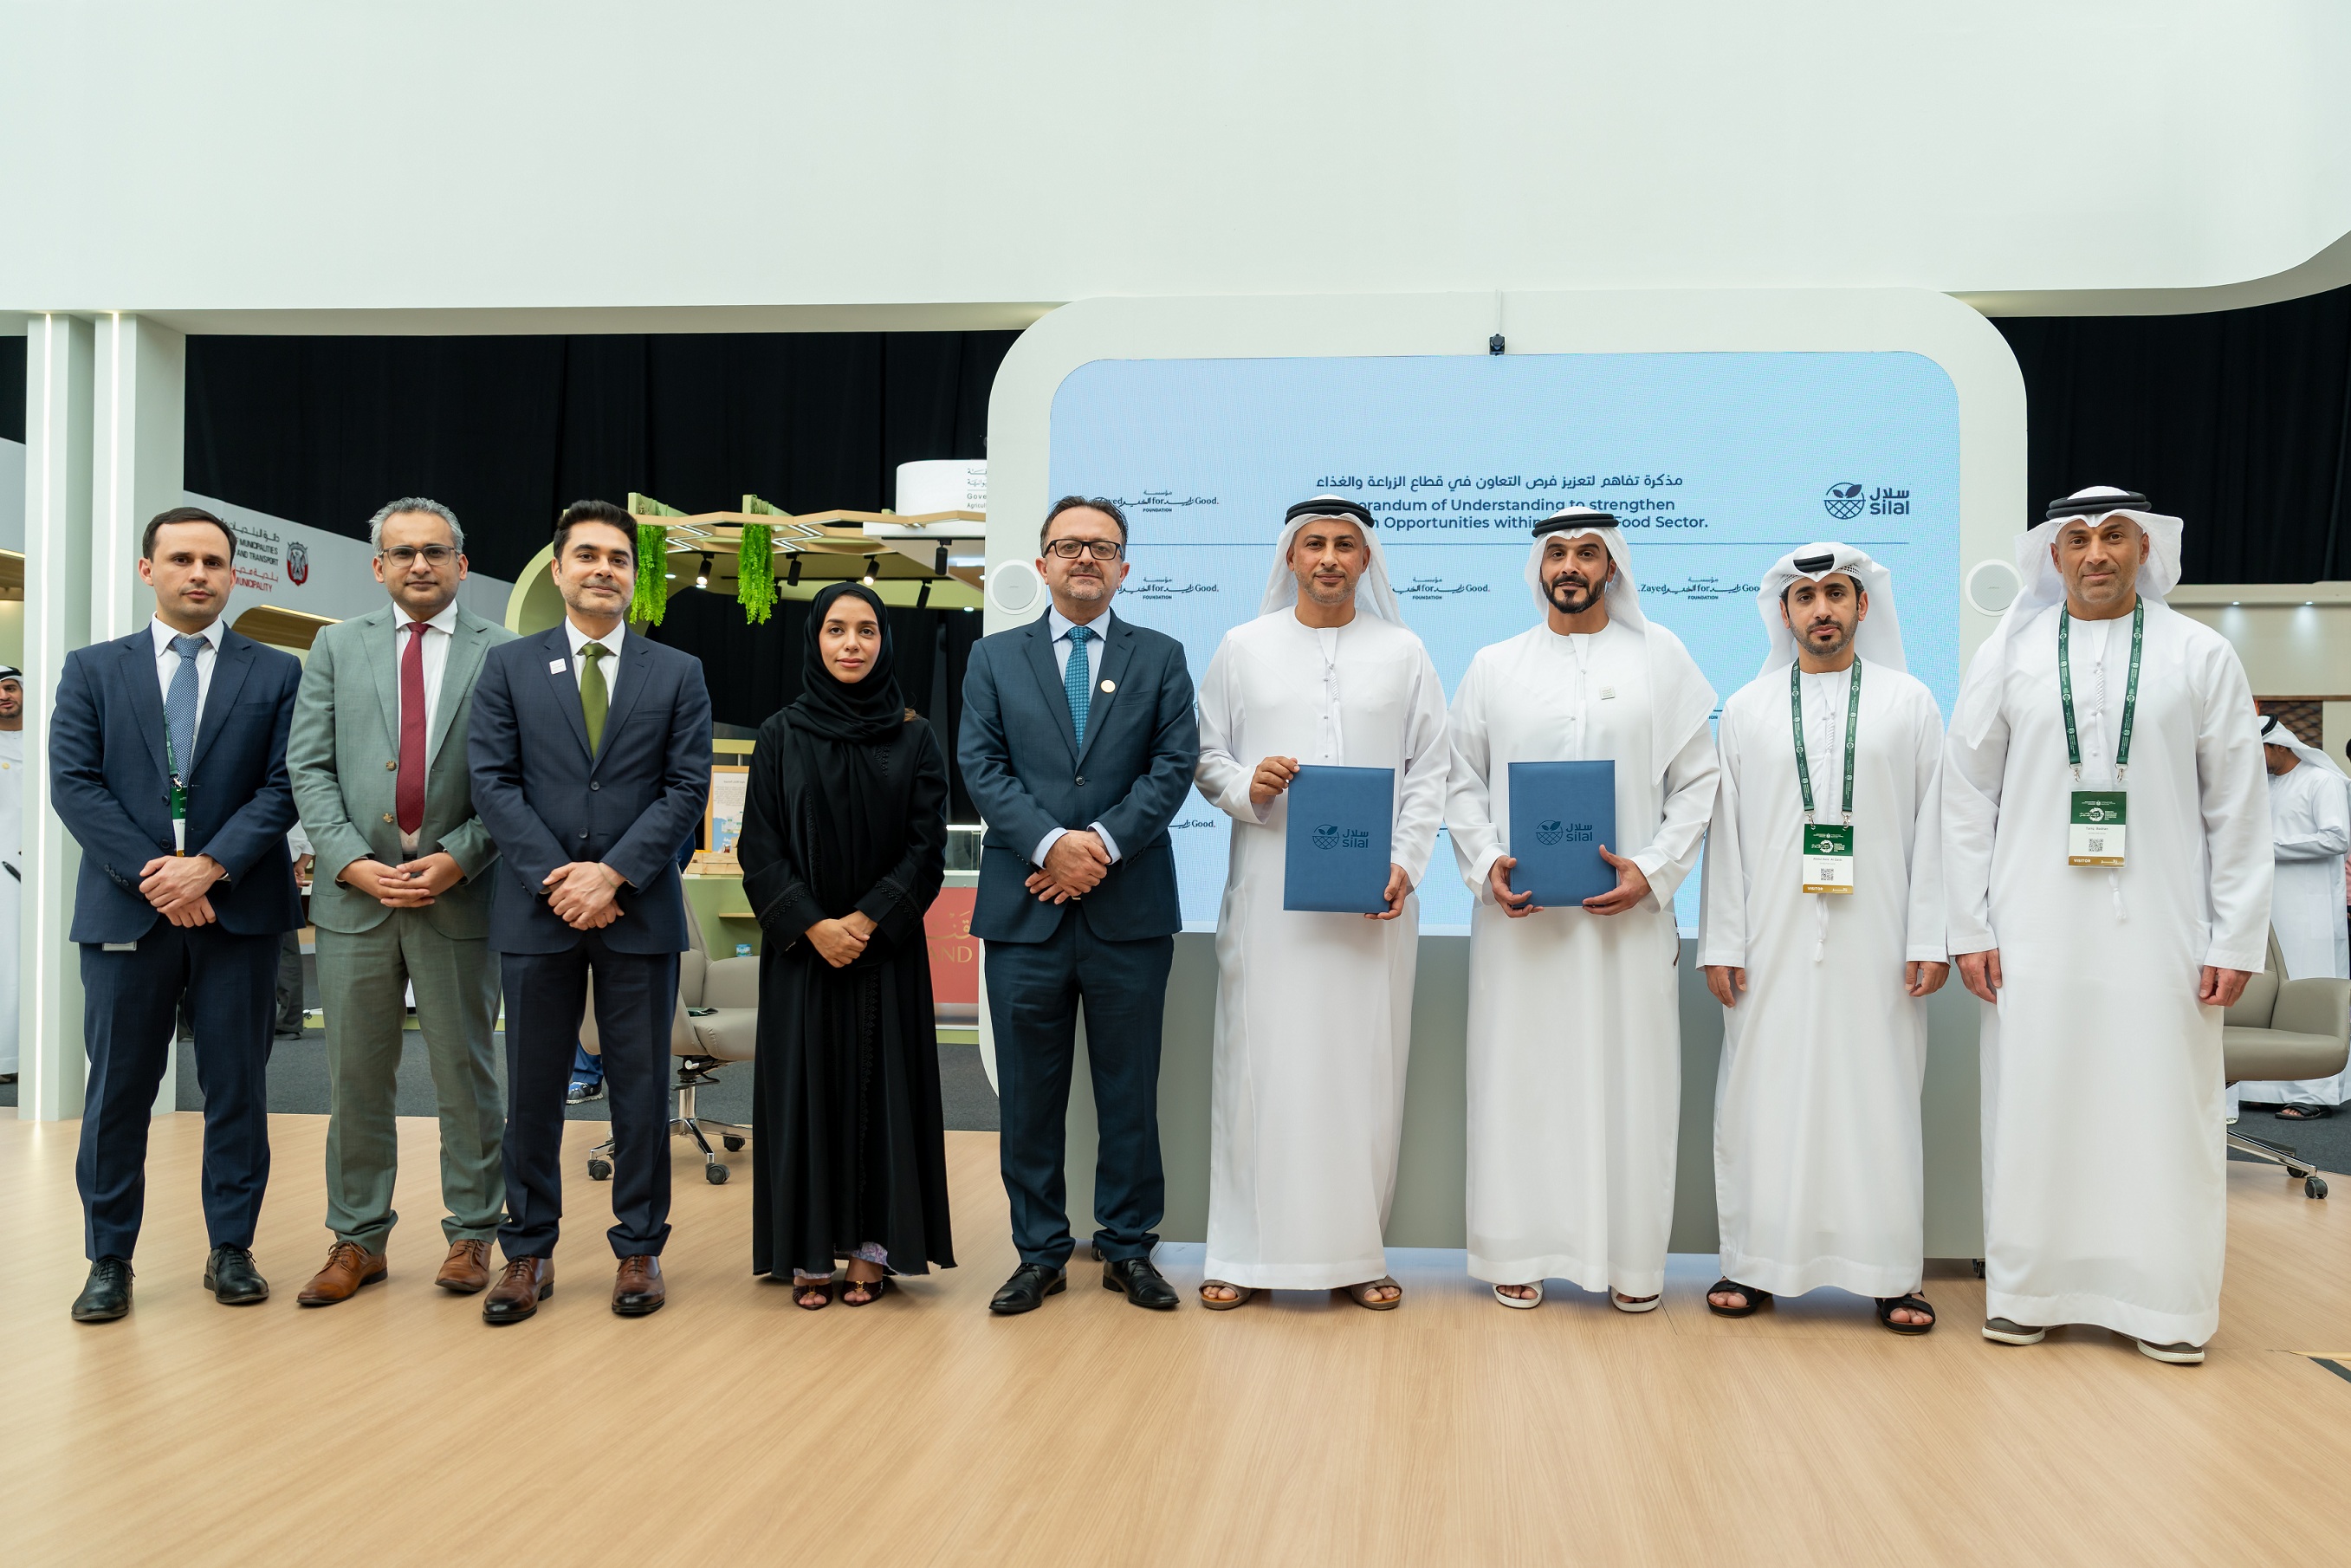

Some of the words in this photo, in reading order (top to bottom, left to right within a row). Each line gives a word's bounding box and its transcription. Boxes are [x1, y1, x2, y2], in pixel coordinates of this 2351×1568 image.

[1316, 476, 1363, 490] والغذاء
[1367, 476, 1406, 489] الزراعة
[1410, 476, 1444, 492] قطاع
[1448, 476, 1472, 492] في
[1475, 475, 1521, 489] التعاون
[1525, 476, 1558, 489] فرص
[1562, 475, 1596, 489] لتعزيز
[1601, 475, 1640, 489] تفاهم
[1644, 473, 1683, 489] مذكرة
[1152, 496, 1163, 505] for
[1869, 487, 1910, 501] سلال
[1358, 499, 1428, 511] orandum
[1431, 498, 1448, 511] of
[1451, 499, 1564, 512] Understanding
[1590, 499, 1675, 514] strengthen
[1869, 499, 1910, 515] silal
[1384, 516, 1490, 532] Opportunities
[1655, 515, 1708, 528] Sector.
[239, 538, 278, 554] MUNICIPALITIES
[236, 549, 248, 558] AND
[249, 552, 278, 566] TRANSPORT
[236, 576, 272, 593] MUNICIPALITY
[1152, 584, 1164, 593] for
[1422, 584, 1434, 593] for
[1697, 584, 1710, 593] for
[1742, 584, 1760, 593] Goo
[1342, 828, 1370, 839] سلال
[1565, 823, 1593, 833] سلال
[1342, 837, 1369, 849] silal
[1565, 831, 1593, 842] silal
